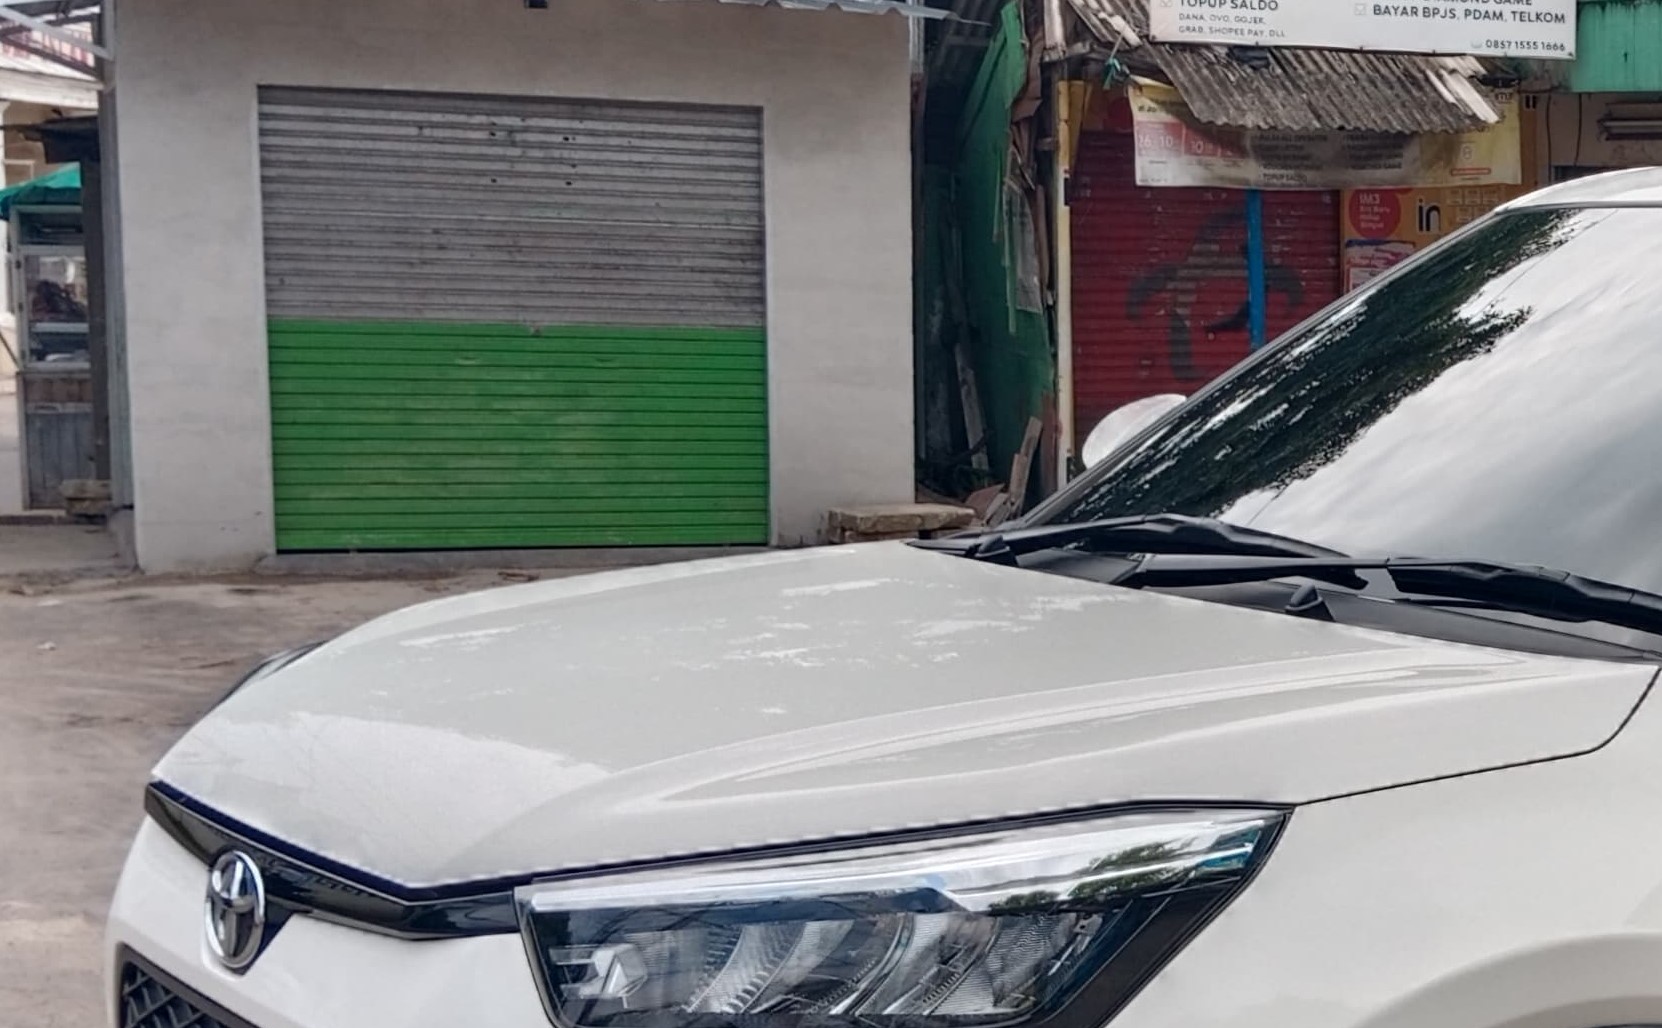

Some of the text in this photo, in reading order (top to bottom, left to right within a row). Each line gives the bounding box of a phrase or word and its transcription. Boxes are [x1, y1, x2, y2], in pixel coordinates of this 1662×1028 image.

[1230, 0, 1279, 11] SALDO
[1373, 5, 1566, 24] BAYAR BPJS, PDAM, TELKOM
